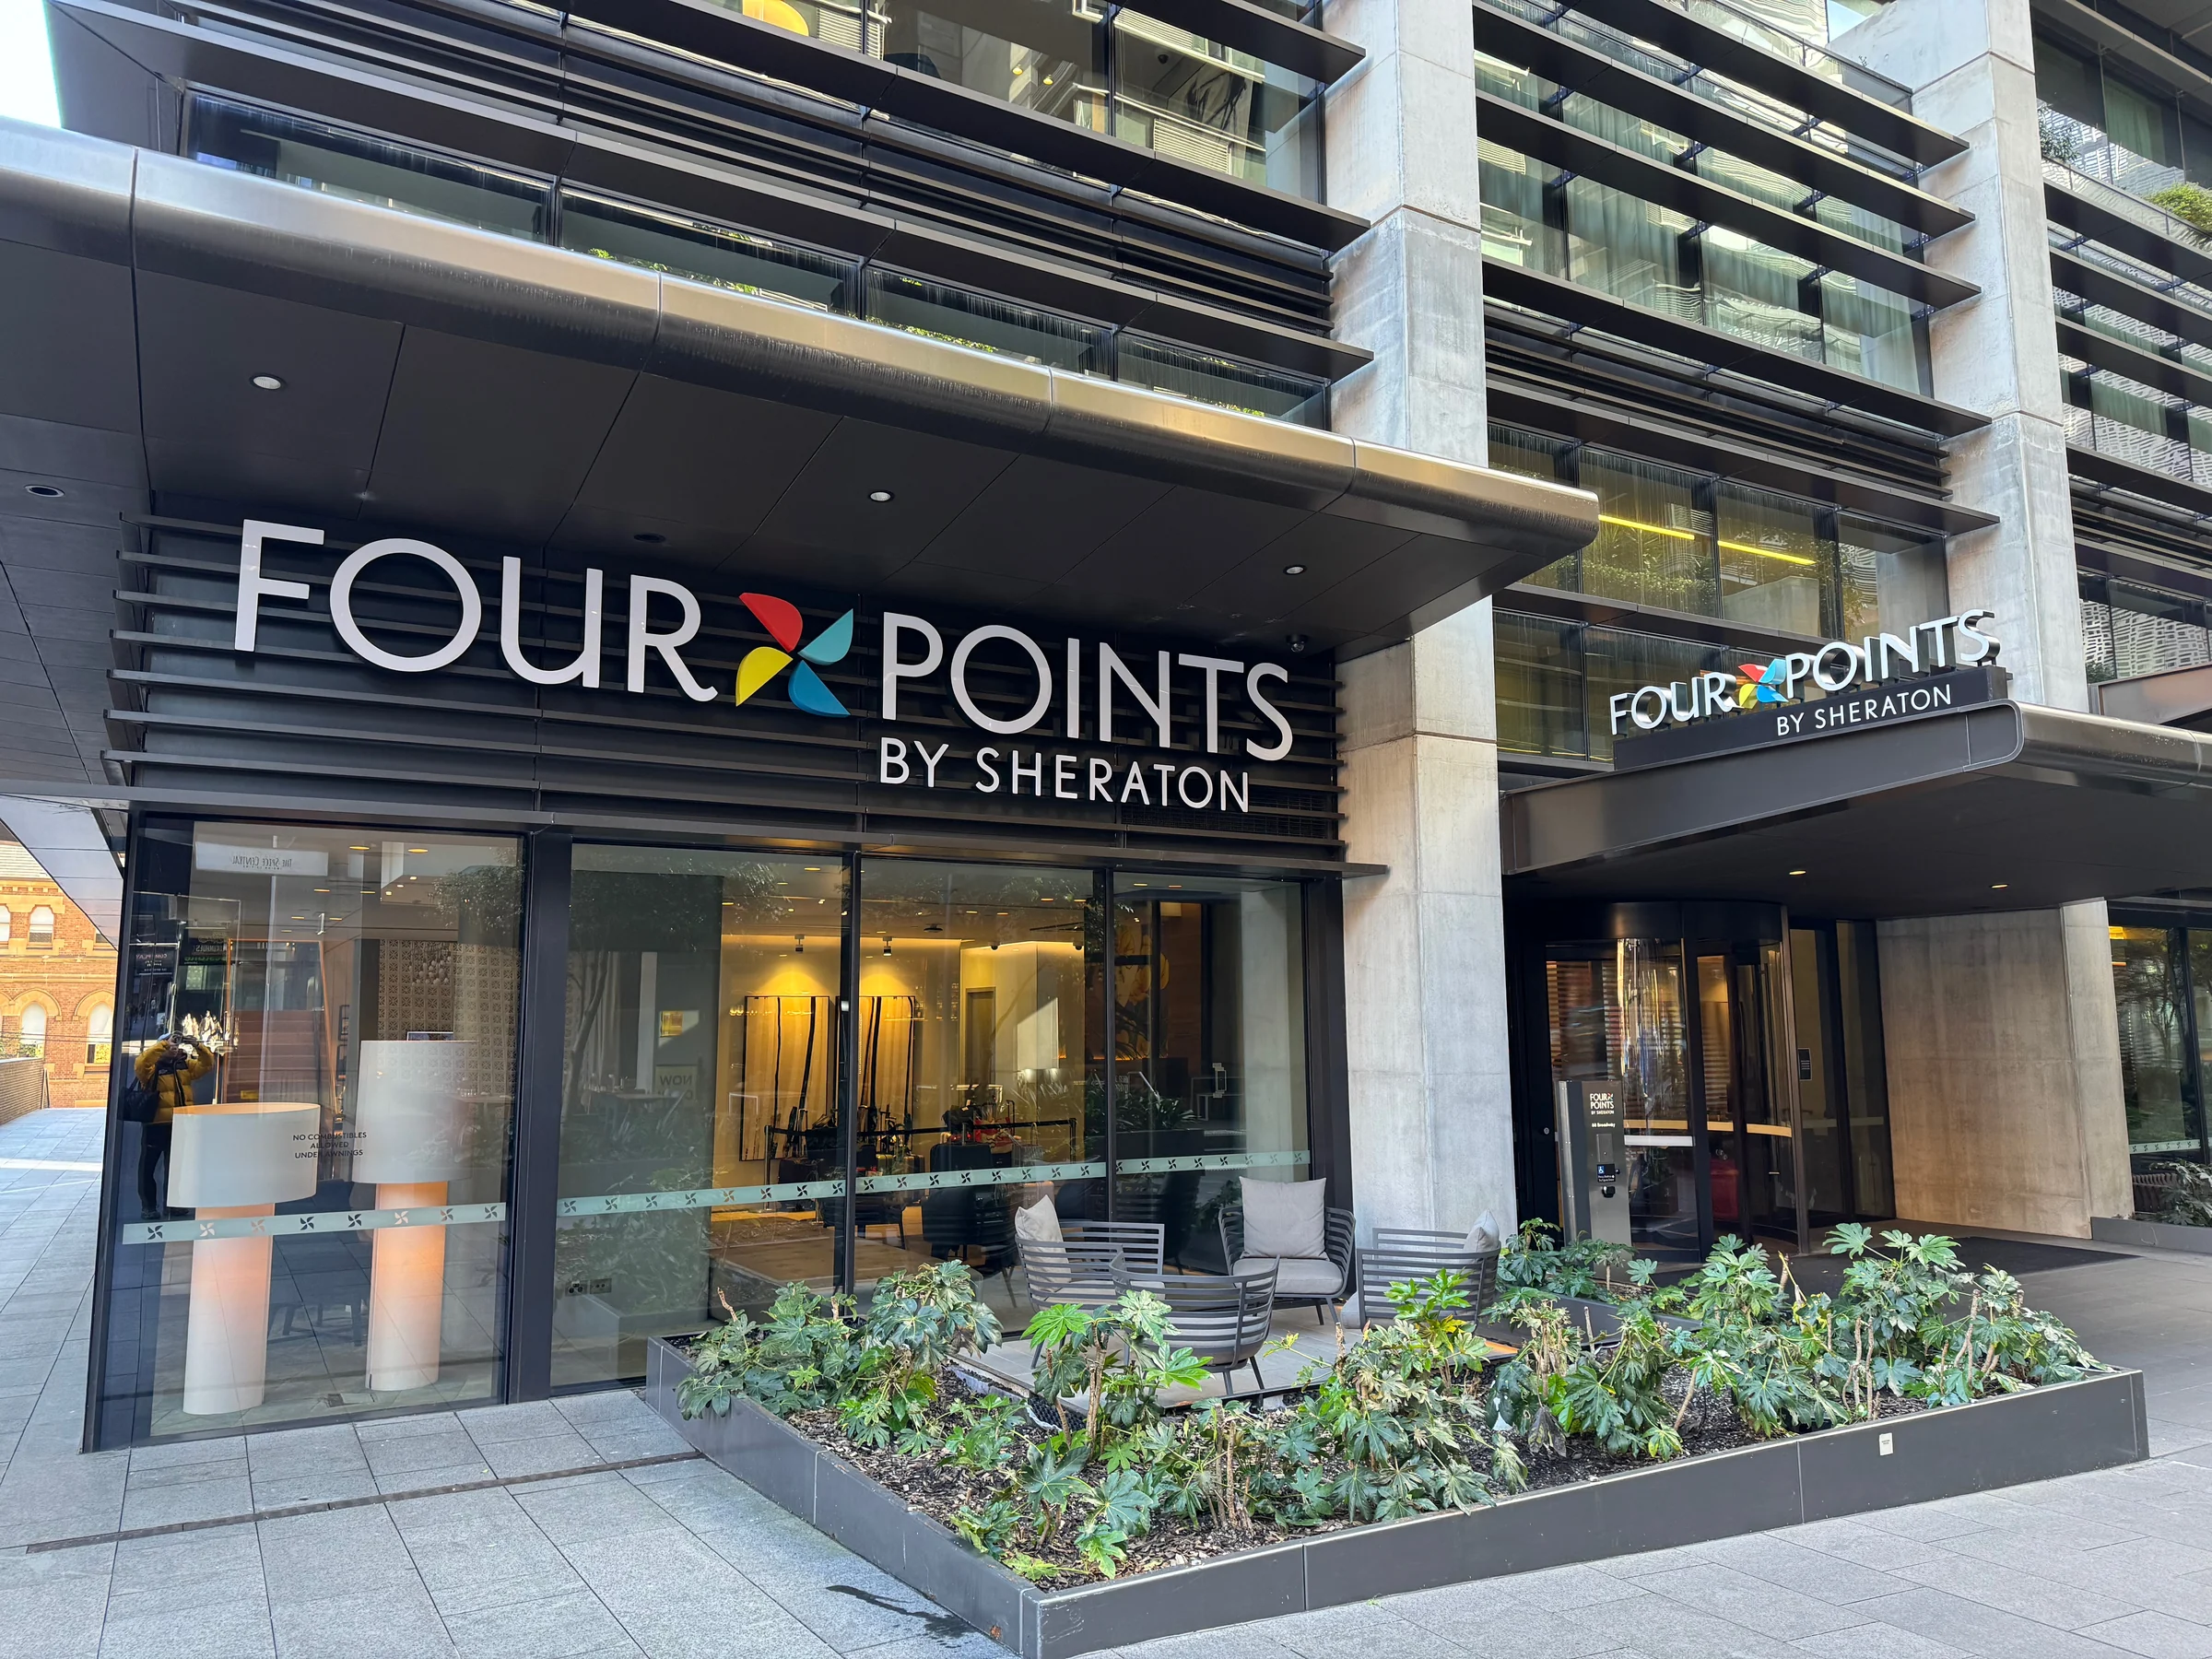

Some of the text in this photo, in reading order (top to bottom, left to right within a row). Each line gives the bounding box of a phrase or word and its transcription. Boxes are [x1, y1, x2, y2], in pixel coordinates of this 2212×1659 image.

[234, 519, 1293, 761] FOUR POINTS
[1609, 608, 1998, 735] FOUR POINTS
[1777, 684, 1951, 736] BY SHERATON
[880, 736, 1249, 813] BY SHERATON
[1590, 1093, 1607, 1101] FOUR
[308, 1131, 367, 1141] COMBUSTIBLES
[310, 1141, 349, 1149] ALLOWED
[325, 1149, 364, 1158] AWNINGS
